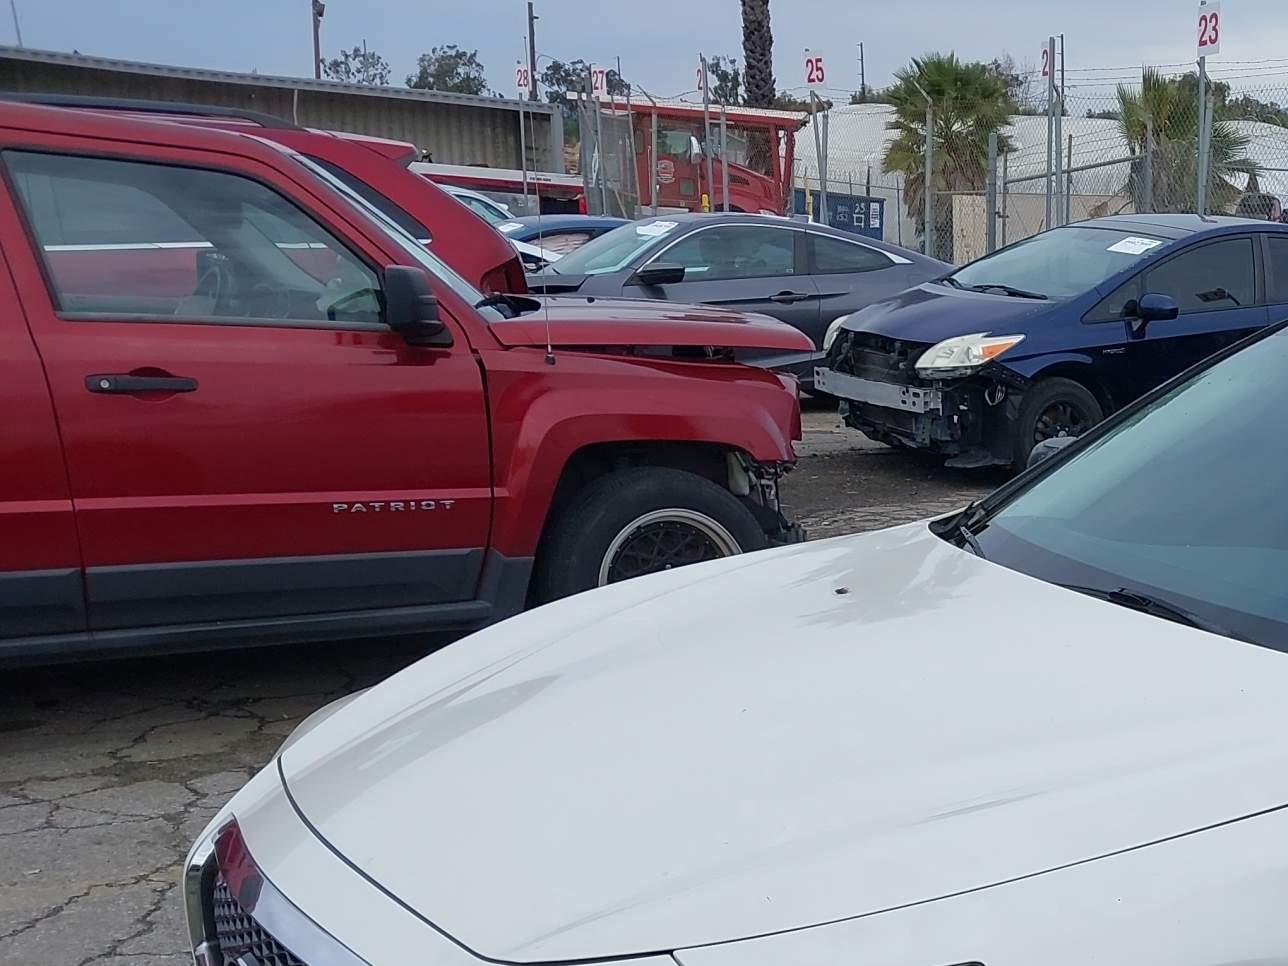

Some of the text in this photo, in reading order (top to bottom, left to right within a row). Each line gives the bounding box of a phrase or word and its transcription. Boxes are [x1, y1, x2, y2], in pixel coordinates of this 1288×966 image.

[1198, 13, 1219, 47] 23
[516, 69, 528, 87] 28
[592, 70, 605, 90] 27
[806, 58, 825, 82] 25
[333, 500, 455, 513] PATRIOT
